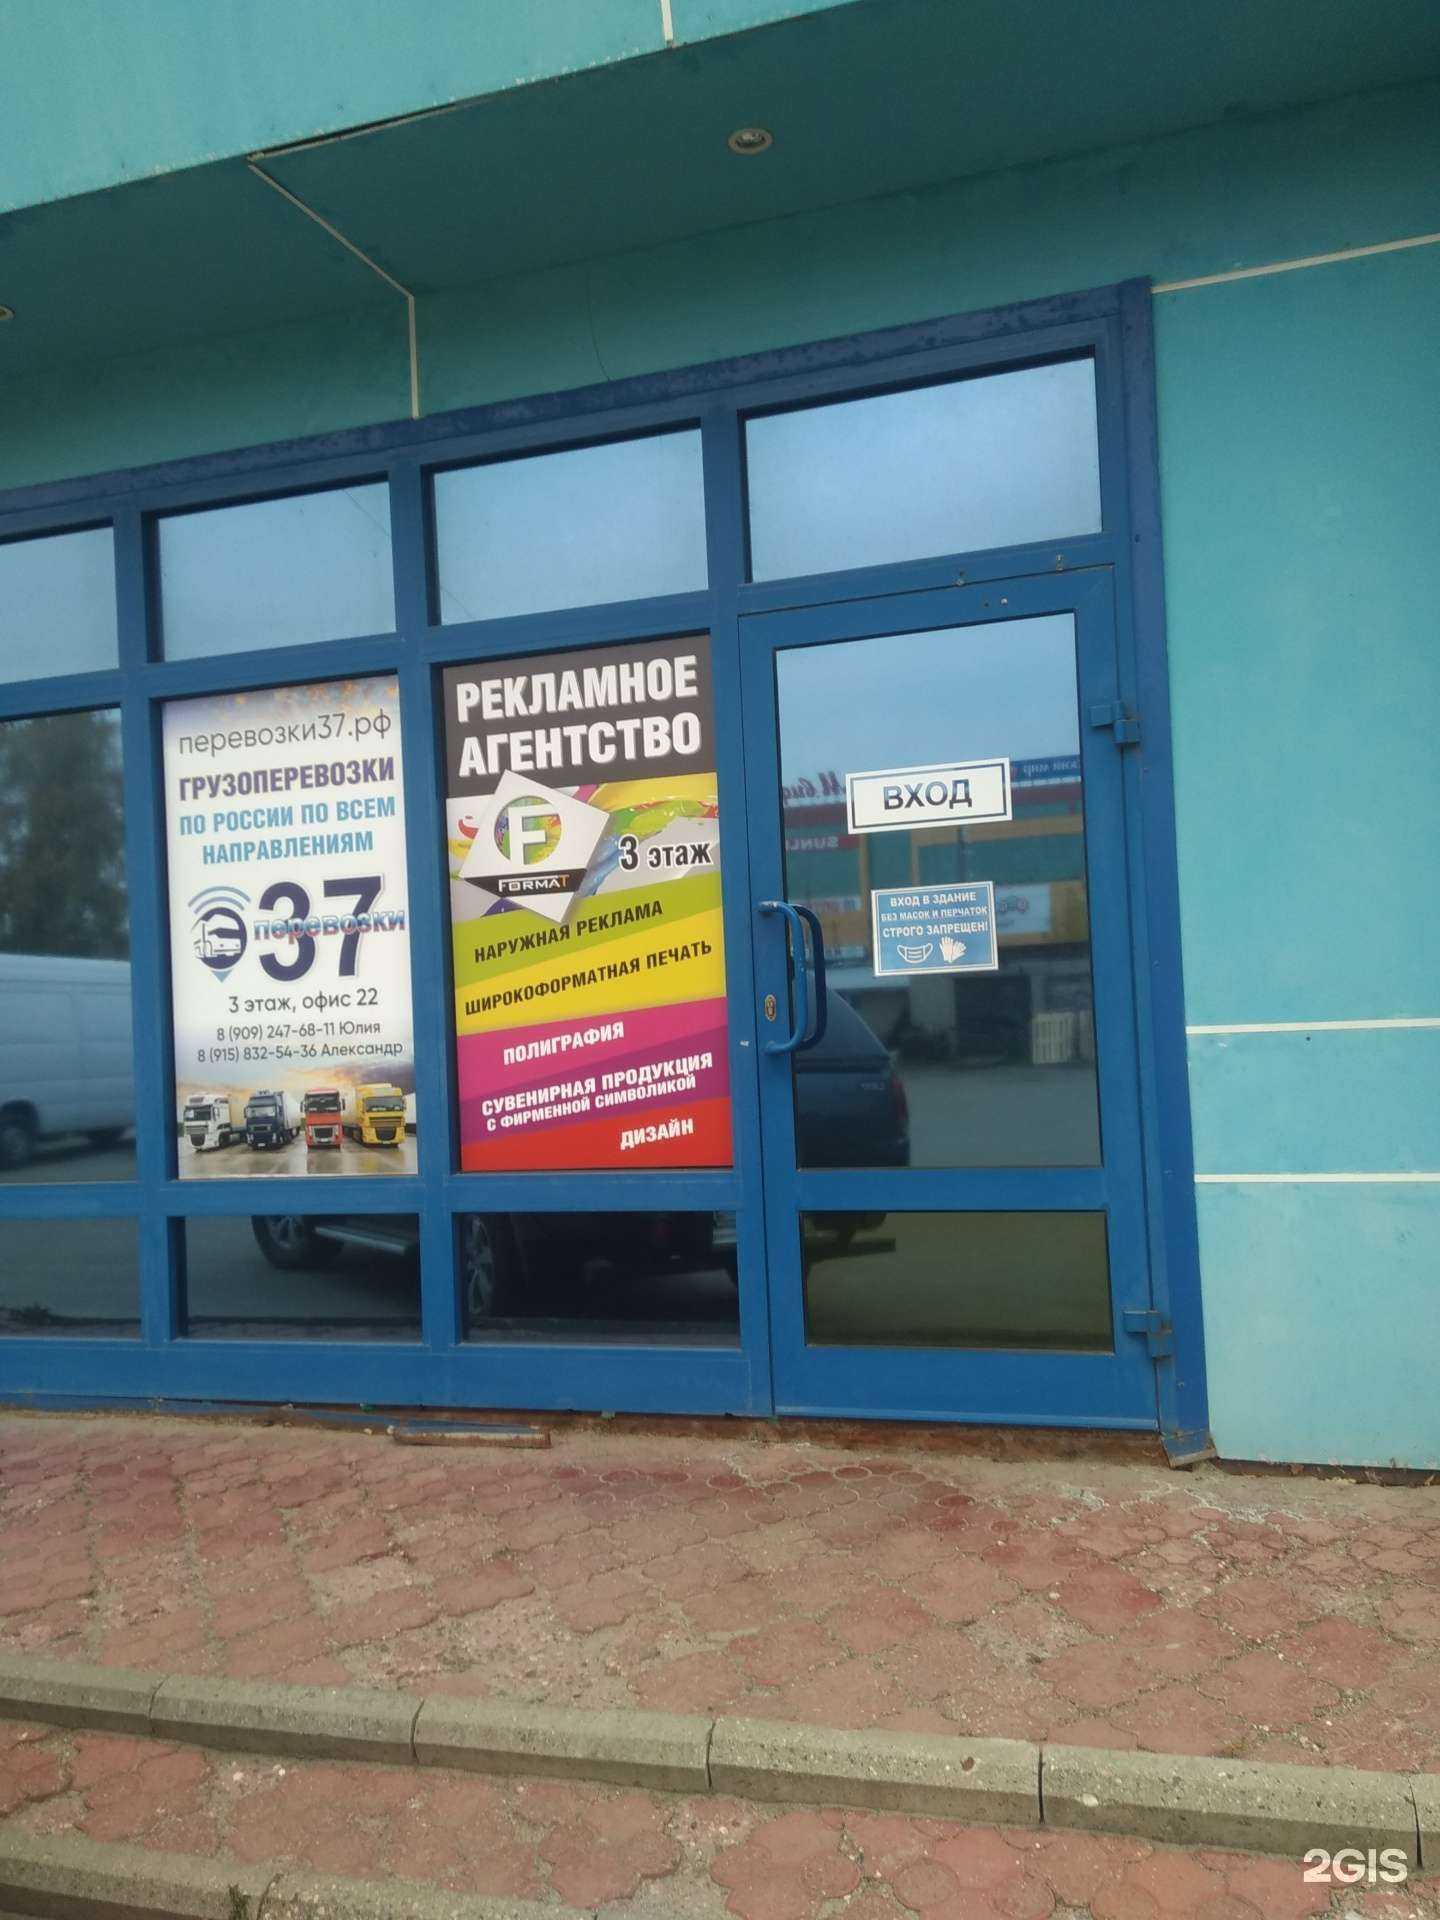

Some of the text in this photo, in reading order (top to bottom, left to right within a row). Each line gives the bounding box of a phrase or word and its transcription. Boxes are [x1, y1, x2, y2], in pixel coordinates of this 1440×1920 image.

[456, 654, 698, 723] РЕКЛАМНОЕ
[179, 709, 392, 757] перевозки37.рф
[458, 711, 701, 777] АГЕНТСТВО
[179, 757, 394, 801] ГРУЗОПЕРЕВОЗКИ
[883, 778, 973, 810] ВХОД
[179, 796, 395, 835] ПО РОССИИ ПО ВСЕМ
[202, 831, 374, 865] НАПРАВЛЕНИЯМ
[618, 834, 713, 871] 3 этаж
[881, 905, 988, 922] БЕЗ МАСОК И ПЕРЧАТОК
[890, 891, 977, 908] ВХОД В ЗДАНИЕ
[253, 910, 407, 945] перевозки
[258, 875, 384, 982] 37
[474, 900, 663, 963] НАРУЖНАЯ РЕКЛАМА
[883, 921, 988, 938] СТРОГО ЗАПРЕЩЕН!
[465, 939, 713, 1016] ШИРОКОФОРМАТНАЯ ПЕЧАТЬ
[228, 987, 378, 1013] 3 этаж, офис 22
[216, 1021, 381, 1041] 8 (909) 247-68-11 Юлия
[503, 1021, 625, 1065] ПОЛИГРАФИЯ
[198, 1043, 404, 1063] 8 (915) 832-54-36 Александр
[481, 1052, 713, 1116] СУВЕНИРНАЯ ПРОДУКЦИЯ
[486, 1074, 696, 1132] С ФИРМЕННОЙ СИМВОЛИКОЙ
[620, 1118, 694, 1150] ДИЗАЙН
